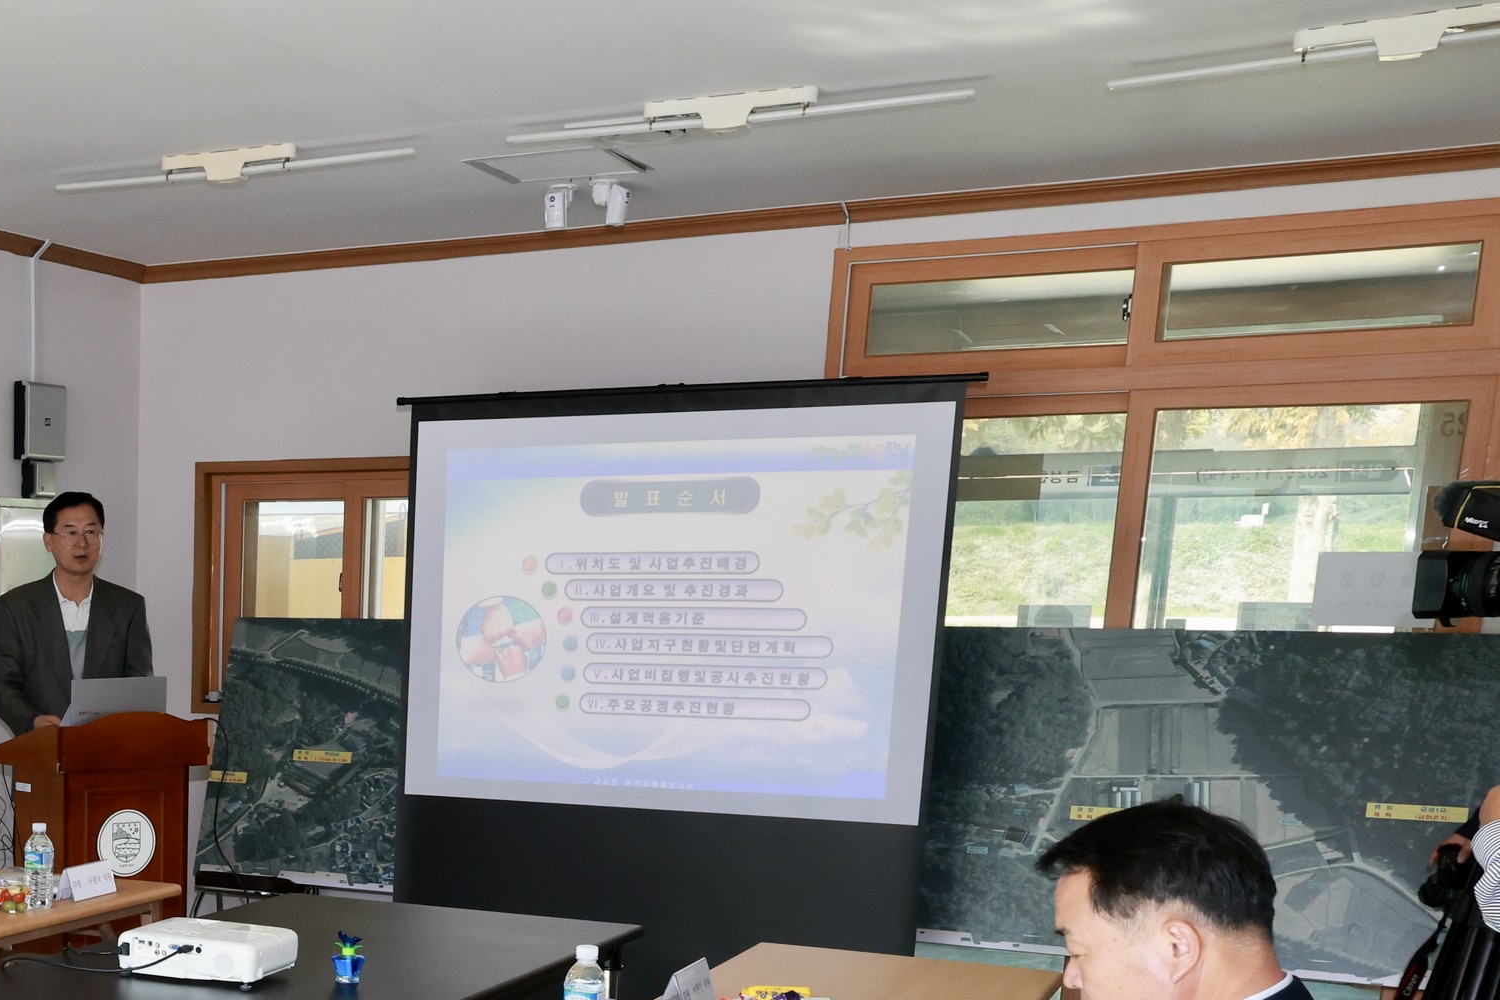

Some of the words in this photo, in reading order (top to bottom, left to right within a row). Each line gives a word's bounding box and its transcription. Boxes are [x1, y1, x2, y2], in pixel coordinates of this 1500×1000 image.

[649, 555, 748, 571] 사업추진배경
[684, 582, 749, 599] 추진경과
[1403, 974, 1419, 996] Canon
